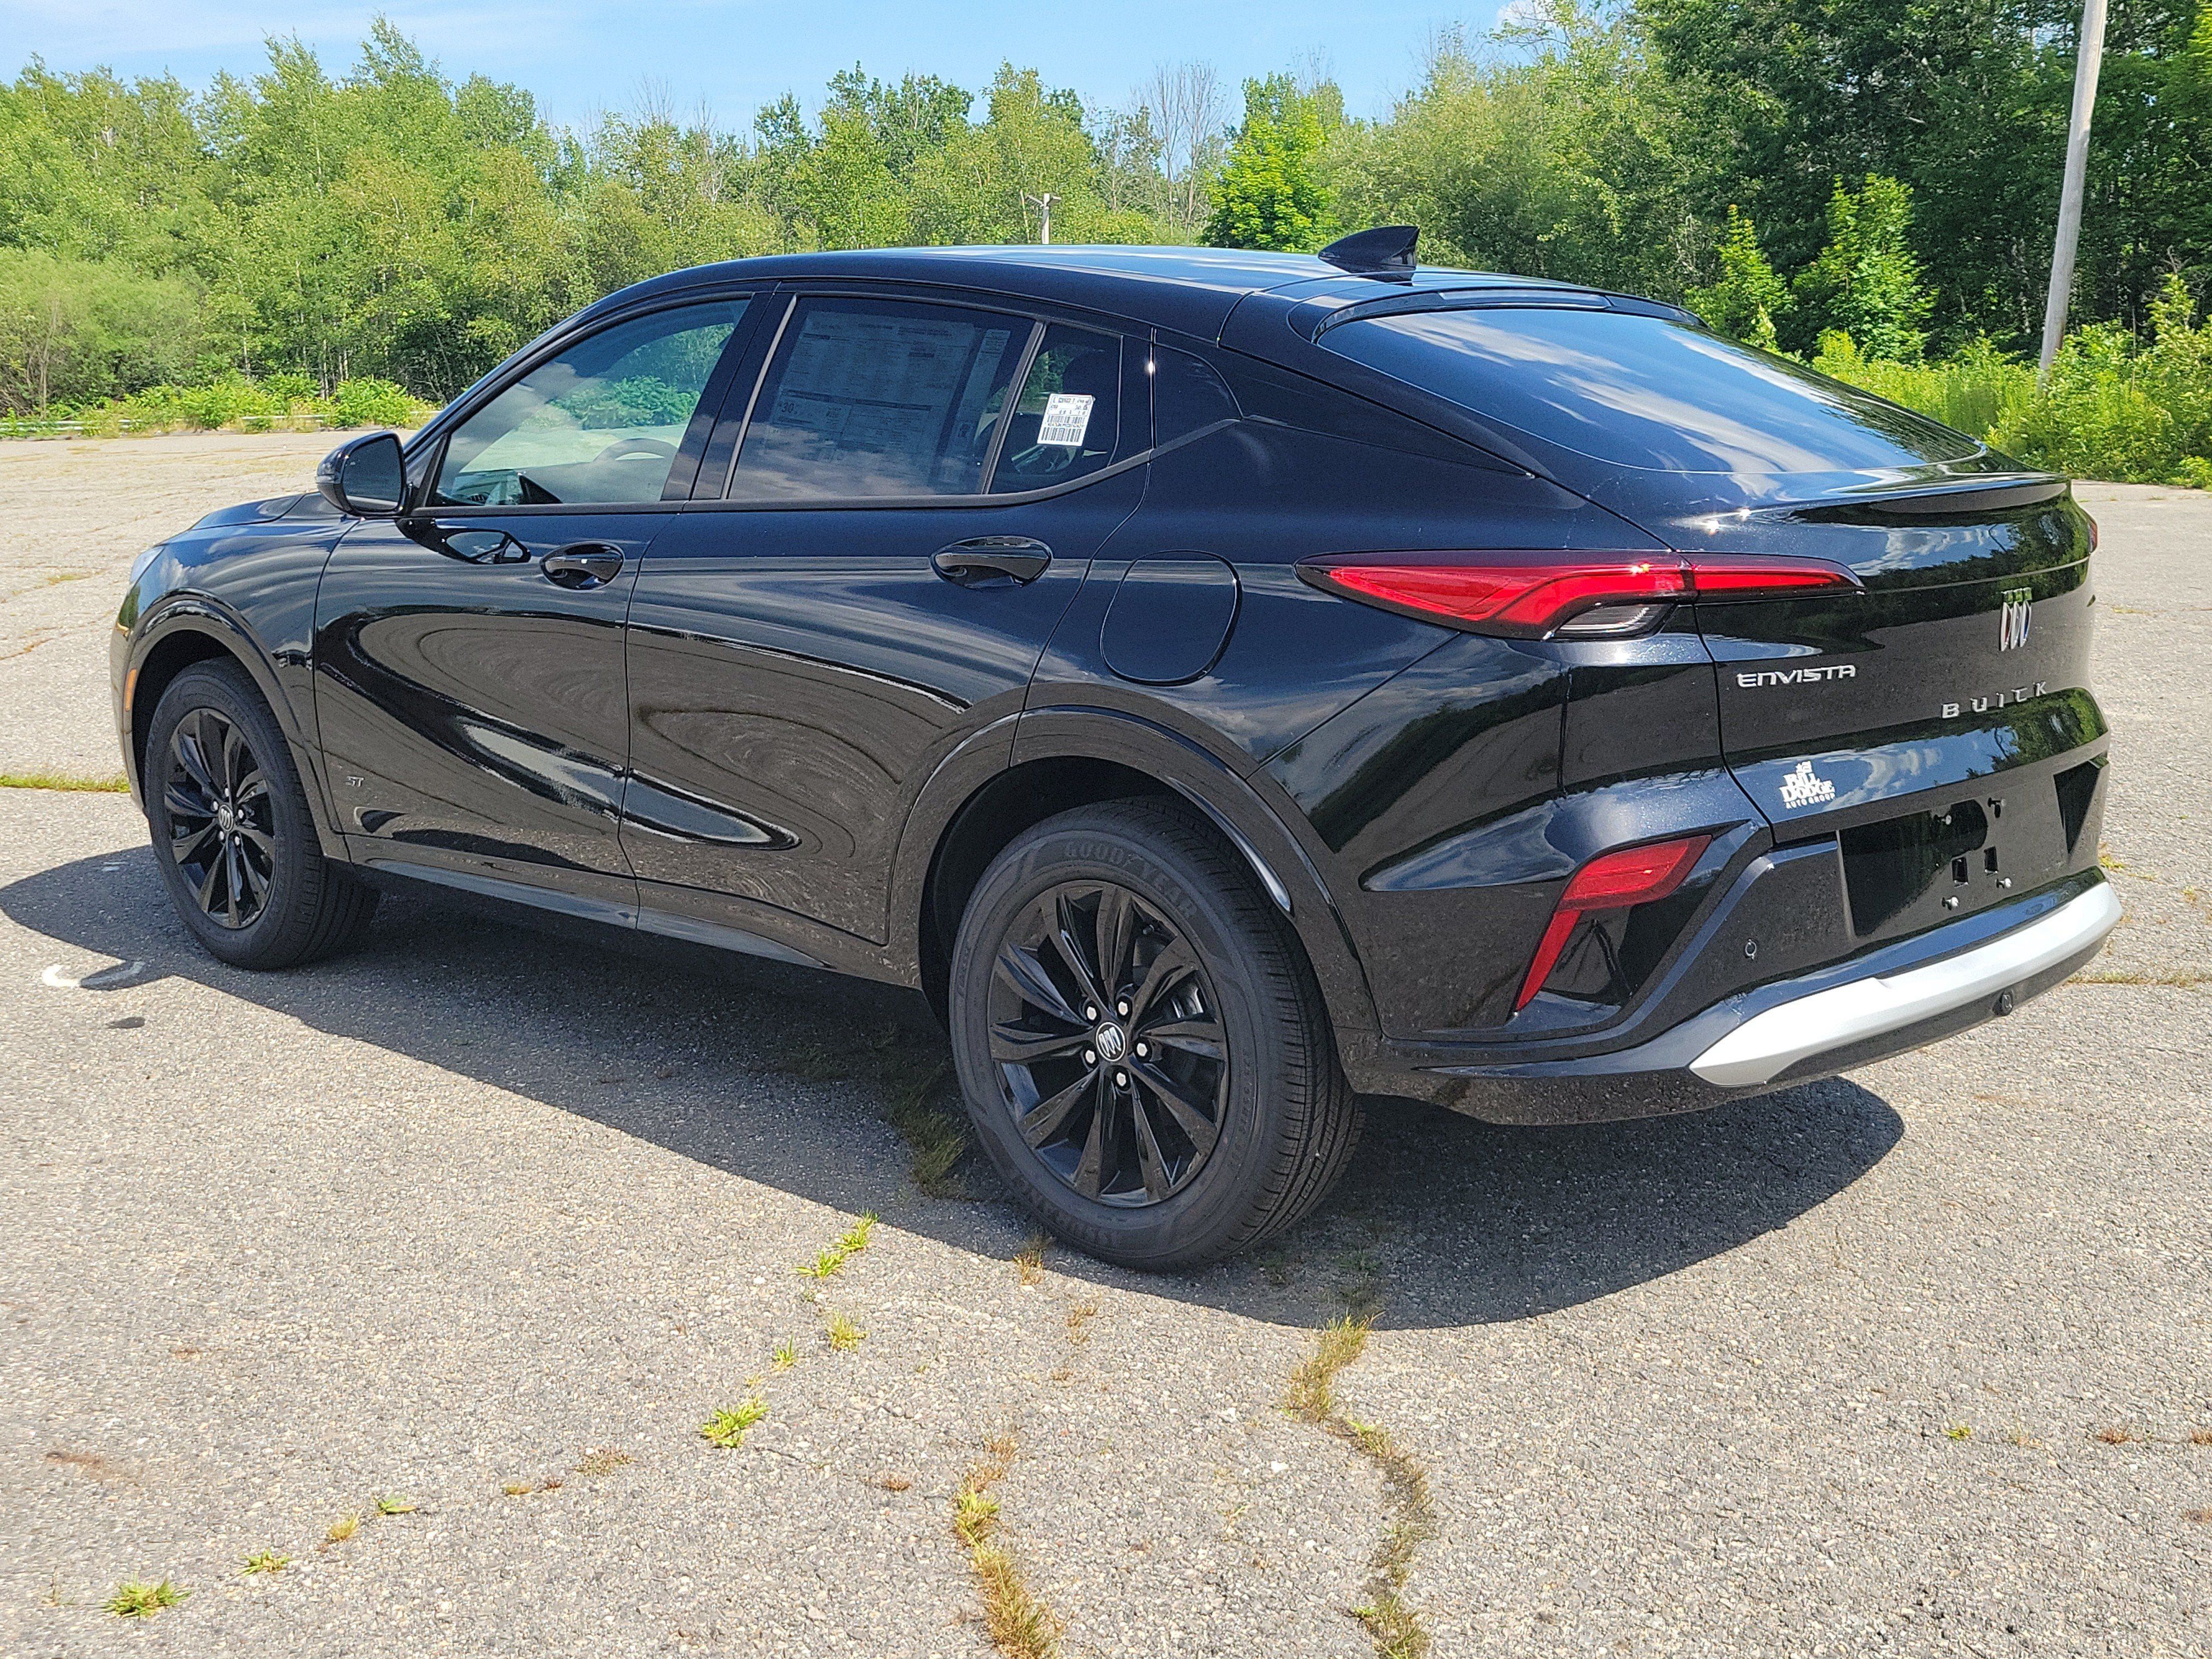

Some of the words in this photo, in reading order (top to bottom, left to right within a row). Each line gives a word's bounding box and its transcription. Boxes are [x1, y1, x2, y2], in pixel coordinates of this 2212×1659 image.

[1736, 664, 1857, 688] ENVISTA
[1941, 681, 2047, 719] BUICK
[345, 775, 365, 787] ST
[1782, 771, 1820, 789] BILL
[1778, 780, 1836, 803] DODGE
[1785, 798, 1808, 809] AUTO
[1808, 793, 1836, 805] GROUP
